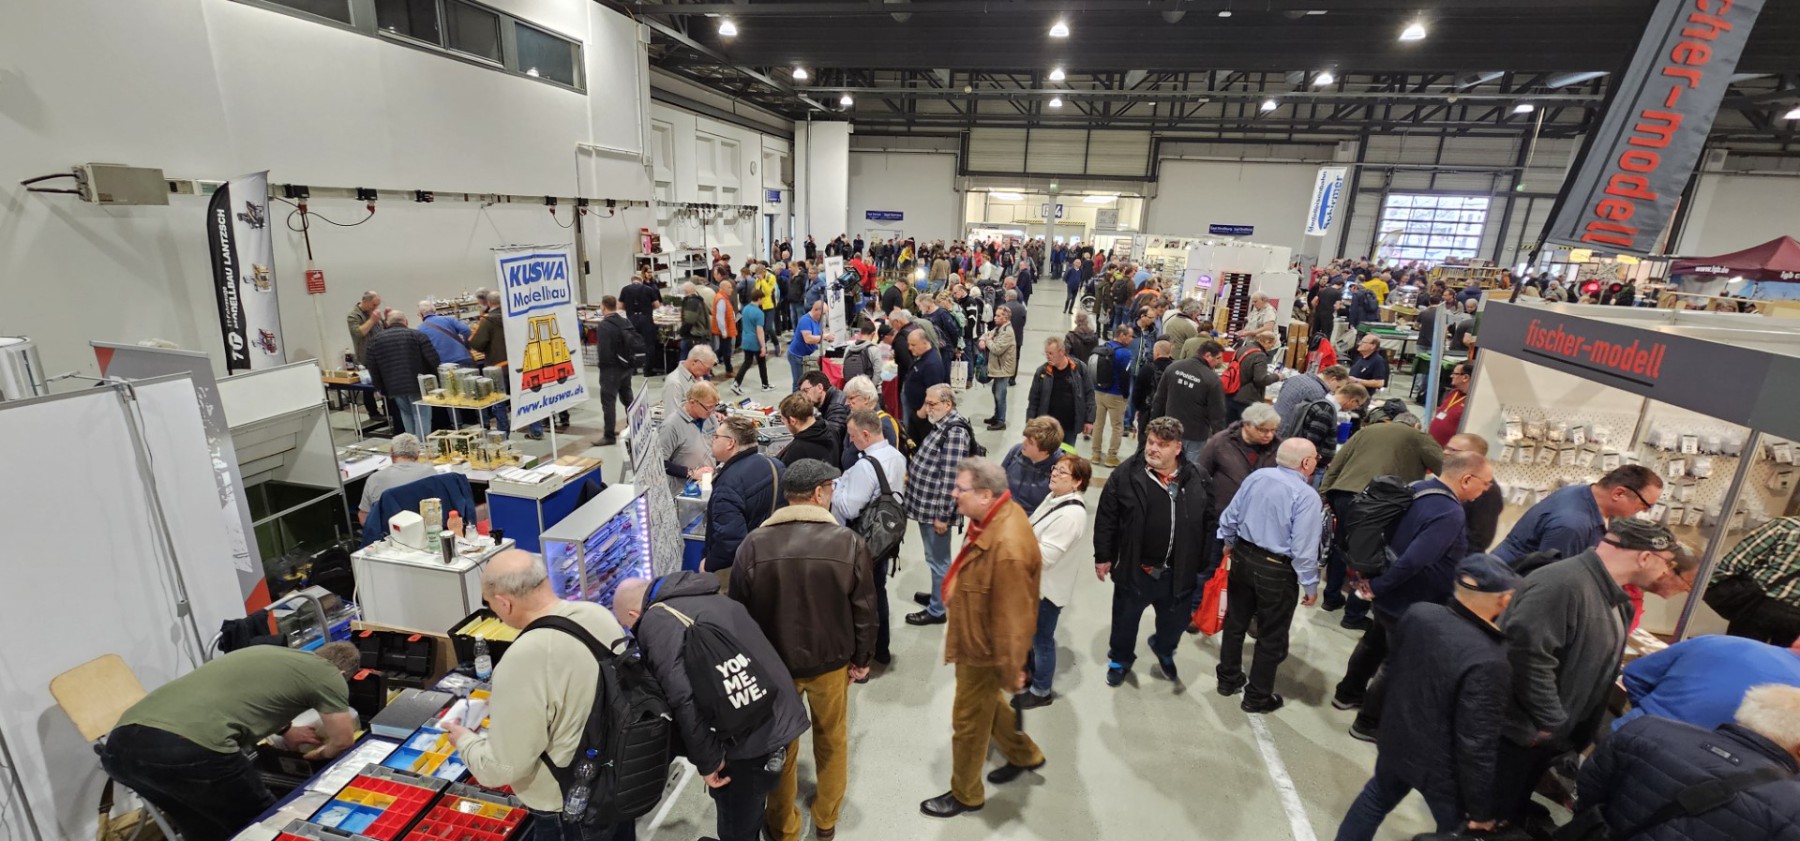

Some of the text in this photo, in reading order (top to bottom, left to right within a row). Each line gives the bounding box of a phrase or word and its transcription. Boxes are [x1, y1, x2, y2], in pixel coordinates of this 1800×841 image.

[216, 208, 231, 267] LANTZSCH
[509, 261, 566, 288] KUSWA
[1525, 318, 1666, 380] fischer-modell
[723, 670, 757, 695] ME.
[728, 683, 768, 709] WE.
